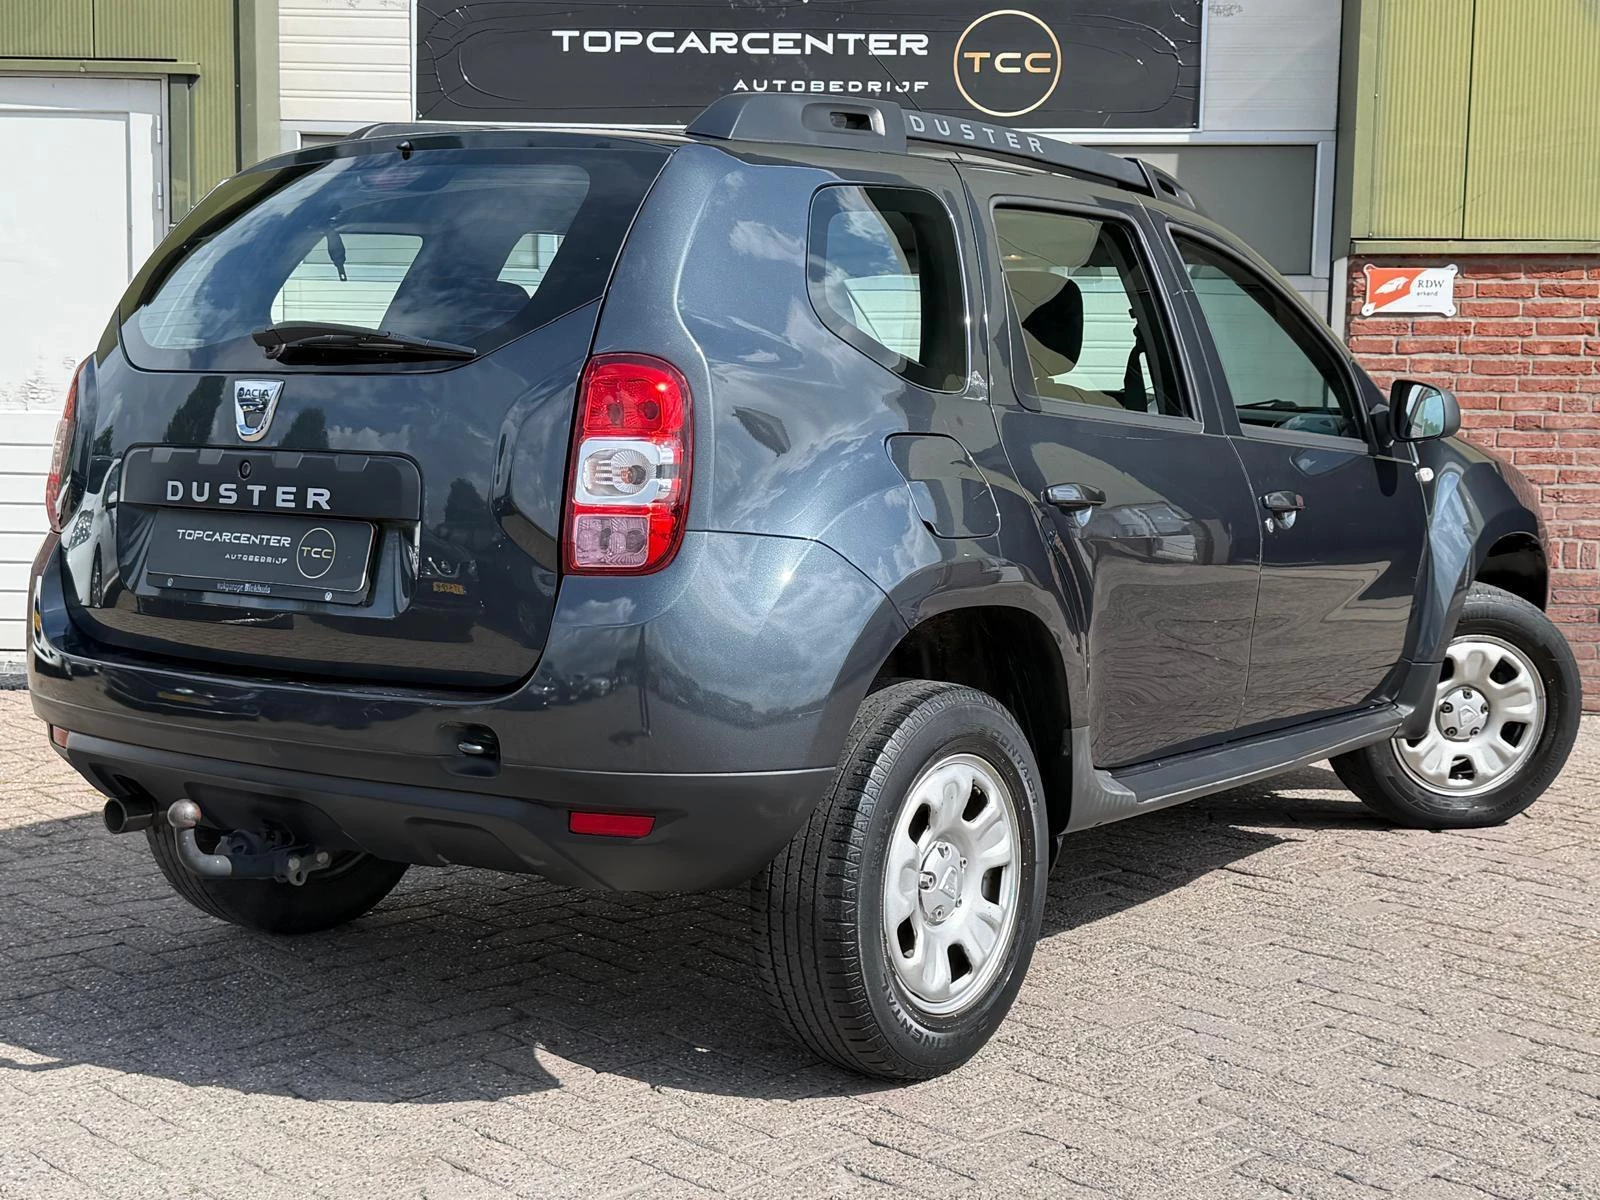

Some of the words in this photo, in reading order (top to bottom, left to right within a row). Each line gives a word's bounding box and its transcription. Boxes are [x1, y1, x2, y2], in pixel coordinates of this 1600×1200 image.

[552, 30, 929, 56] TOPCARCENTER
[964, 52, 1053, 74] TCC
[733, 78, 929, 94] AUTOBEDRIJF
[908, 115, 1044, 154] DUSTER
[1417, 279, 1445, 289] RDW
[237, 386, 270, 399] DACIA
[166, 480, 331, 511] DUSTER
[176, 529, 292, 548] TOPCARCENTER
[300, 546, 333, 559] TCC
